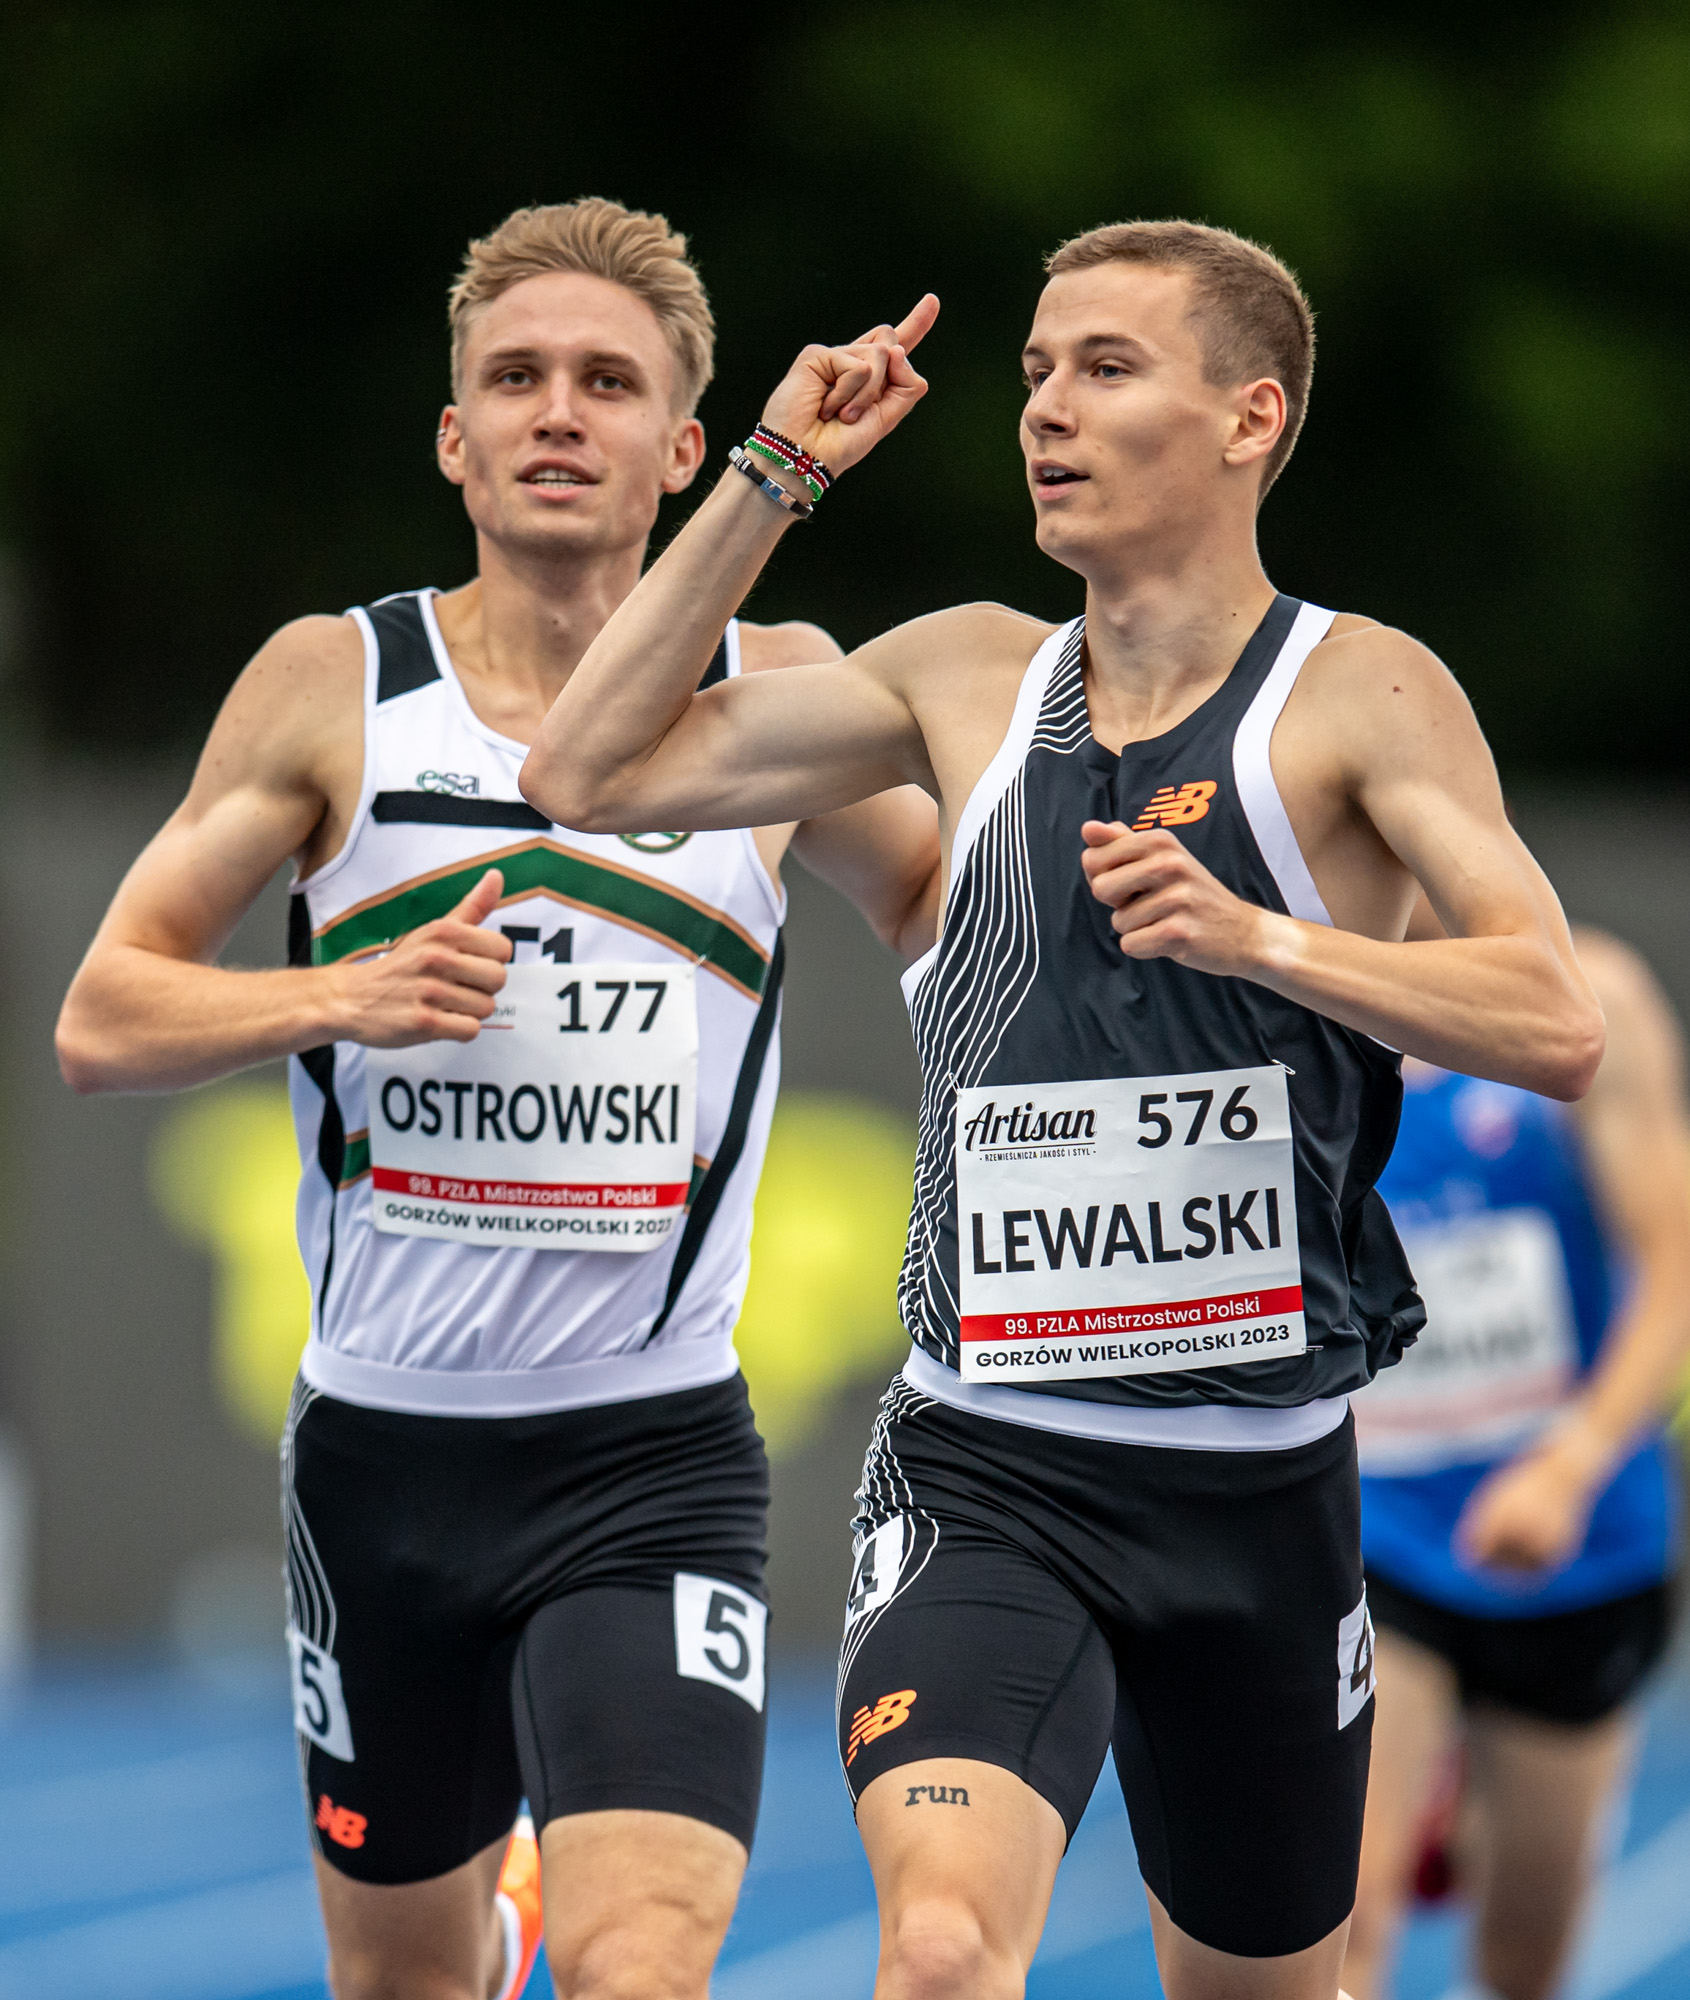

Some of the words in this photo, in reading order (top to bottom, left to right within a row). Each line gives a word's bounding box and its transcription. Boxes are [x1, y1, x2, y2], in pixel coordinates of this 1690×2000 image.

[557, 981, 668, 1034] 177
[380, 1076, 680, 1144] OSTROWSKI
[964, 1101, 1097, 1152] Artisan
[1136, 1085, 1259, 1149] 576
[984, 1150, 1037, 1162] RZEMIEŚLNICZA
[1039, 1148, 1066, 1159] JAKOŚĆ
[1067, 1149, 1071, 1157] I
[1072, 1148, 1091, 1157] STYL
[408, 1176, 435, 1193] 99.
[438, 1180, 480, 1201] PZLA
[484, 1184, 598, 1206] Mistrzostwa
[602, 1187, 657, 1206] Polski
[385, 1202, 471, 1228] GORZÓW
[476, 1215, 630, 1235] WIELKOPOLSKI
[971, 1187, 1282, 1275] LEWALSKI
[1004, 1318, 1033, 1336] 99.
[1036, 1313, 1080, 1335] PZLA
[1084, 1306, 1202, 1332] Mistrzostwa
[1206, 1296, 1261, 1319] Polski
[976, 1344, 1073, 1368] GORZÓW
[1078, 1332, 1236, 1363] WIELKOPOLSKI
[1240, 1324, 1290, 1347] 2023
[850, 1537, 878, 1619] 4
[704, 1589, 749, 1682] 5
[301, 1646, 329, 1737] 5
[905, 1785, 970, 1807] run
